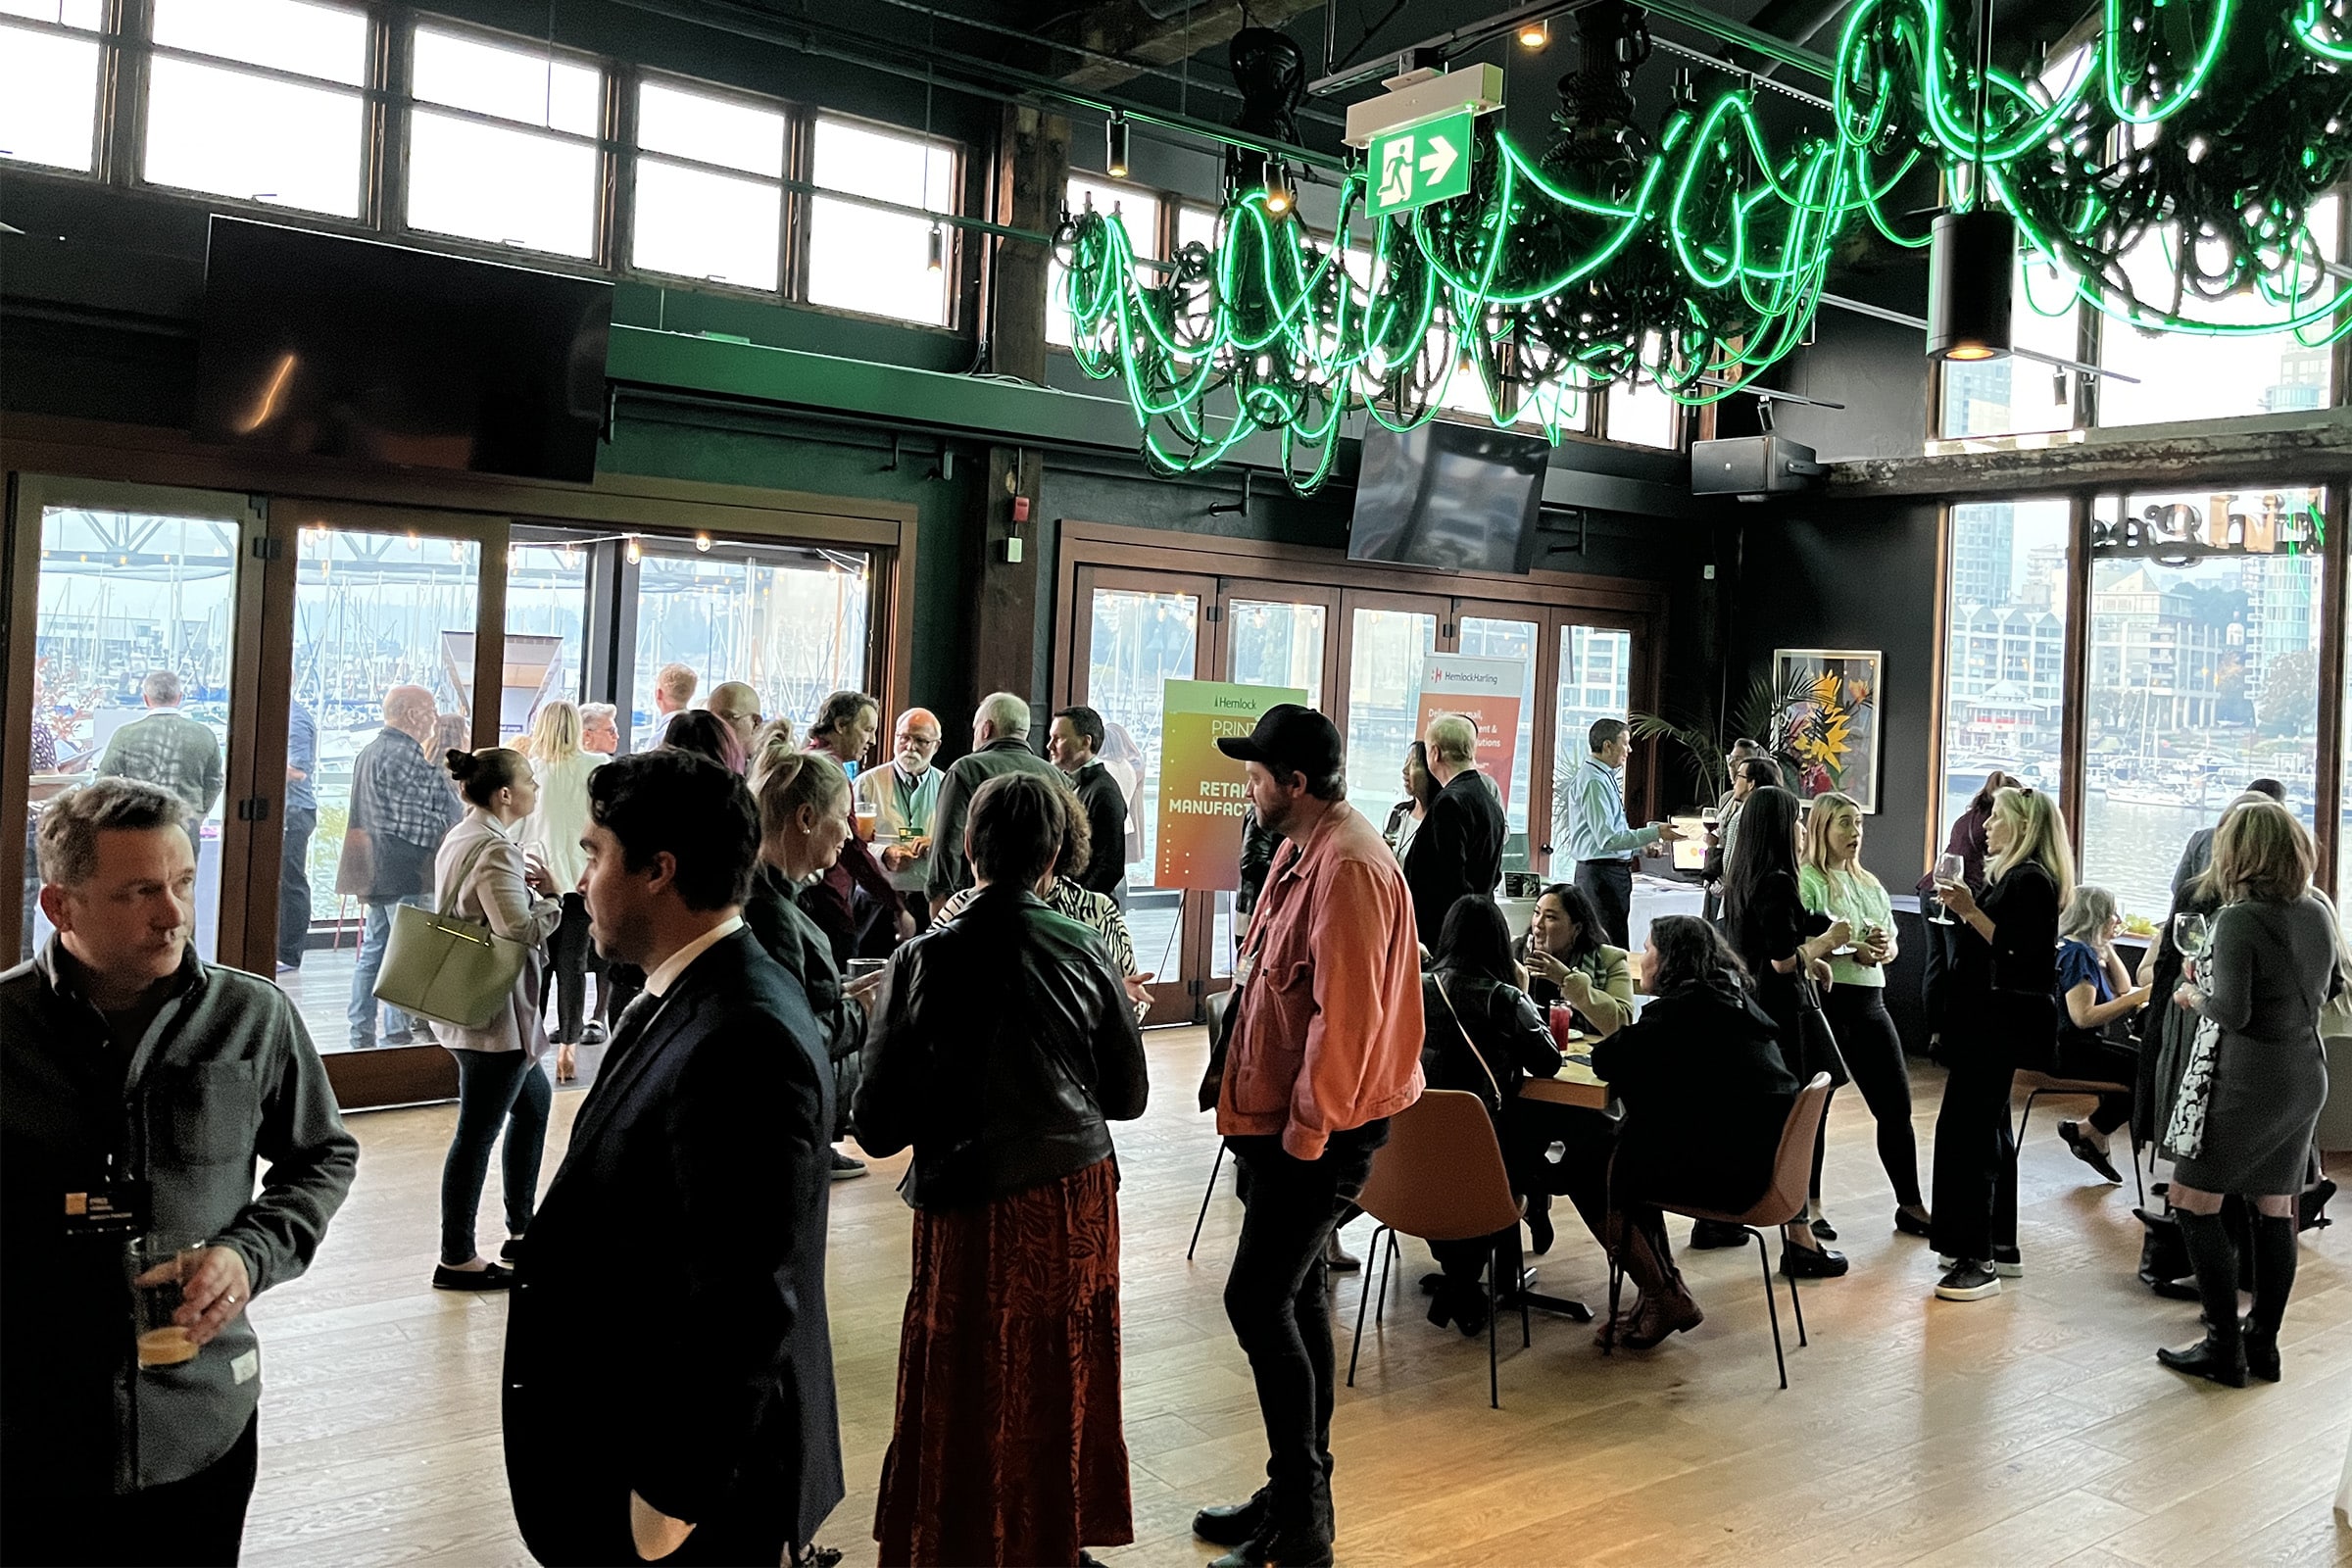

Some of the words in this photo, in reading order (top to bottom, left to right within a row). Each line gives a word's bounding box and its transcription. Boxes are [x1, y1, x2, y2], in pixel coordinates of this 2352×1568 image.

[1445, 671, 1498, 685] HemlockHarling
[1219, 697, 1256, 710] Hemlock
[1200, 781, 1246, 799] RETAI
[1169, 799, 1251, 816] MANUFACT
